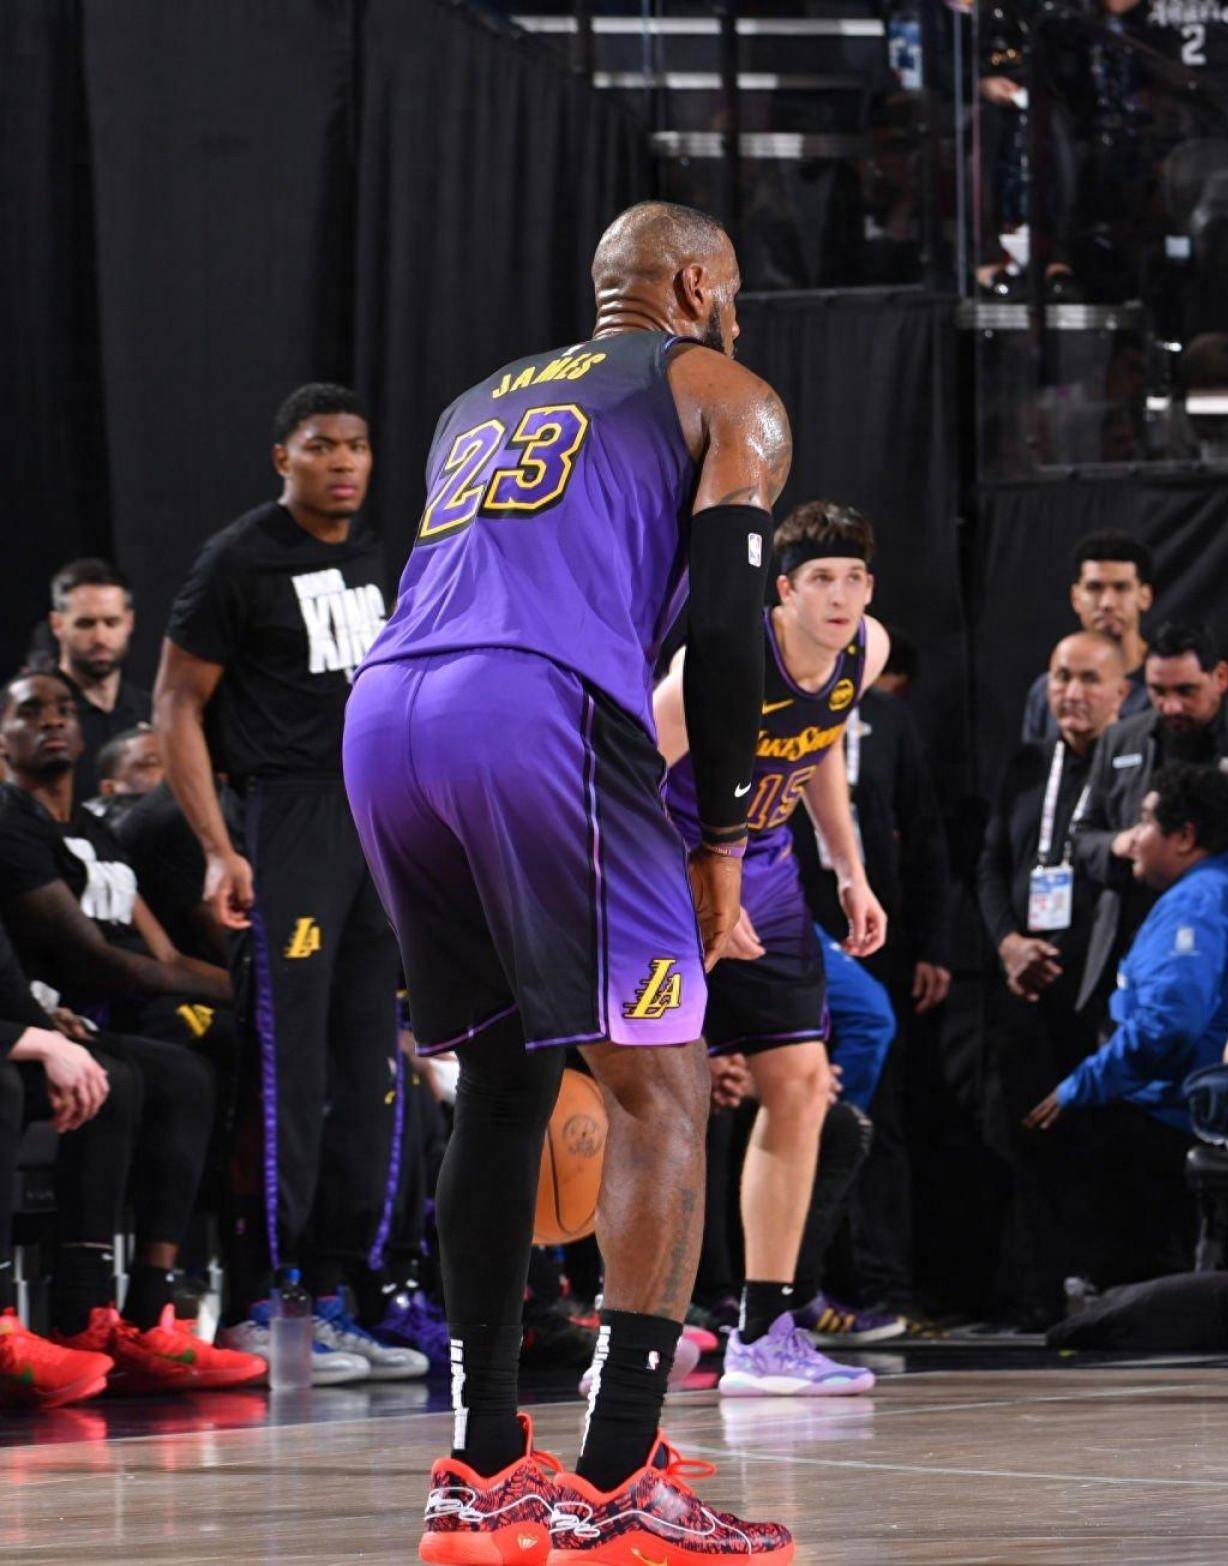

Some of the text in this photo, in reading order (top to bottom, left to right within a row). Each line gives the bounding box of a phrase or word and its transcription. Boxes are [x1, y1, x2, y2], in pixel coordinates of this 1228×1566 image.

[1180, 23, 1207, 66] 2
[491, 353, 607, 399] JAMES
[415, 403, 592, 546] 23
[747, 764, 817, 831] 15
[623, 957, 681, 1019] LA
